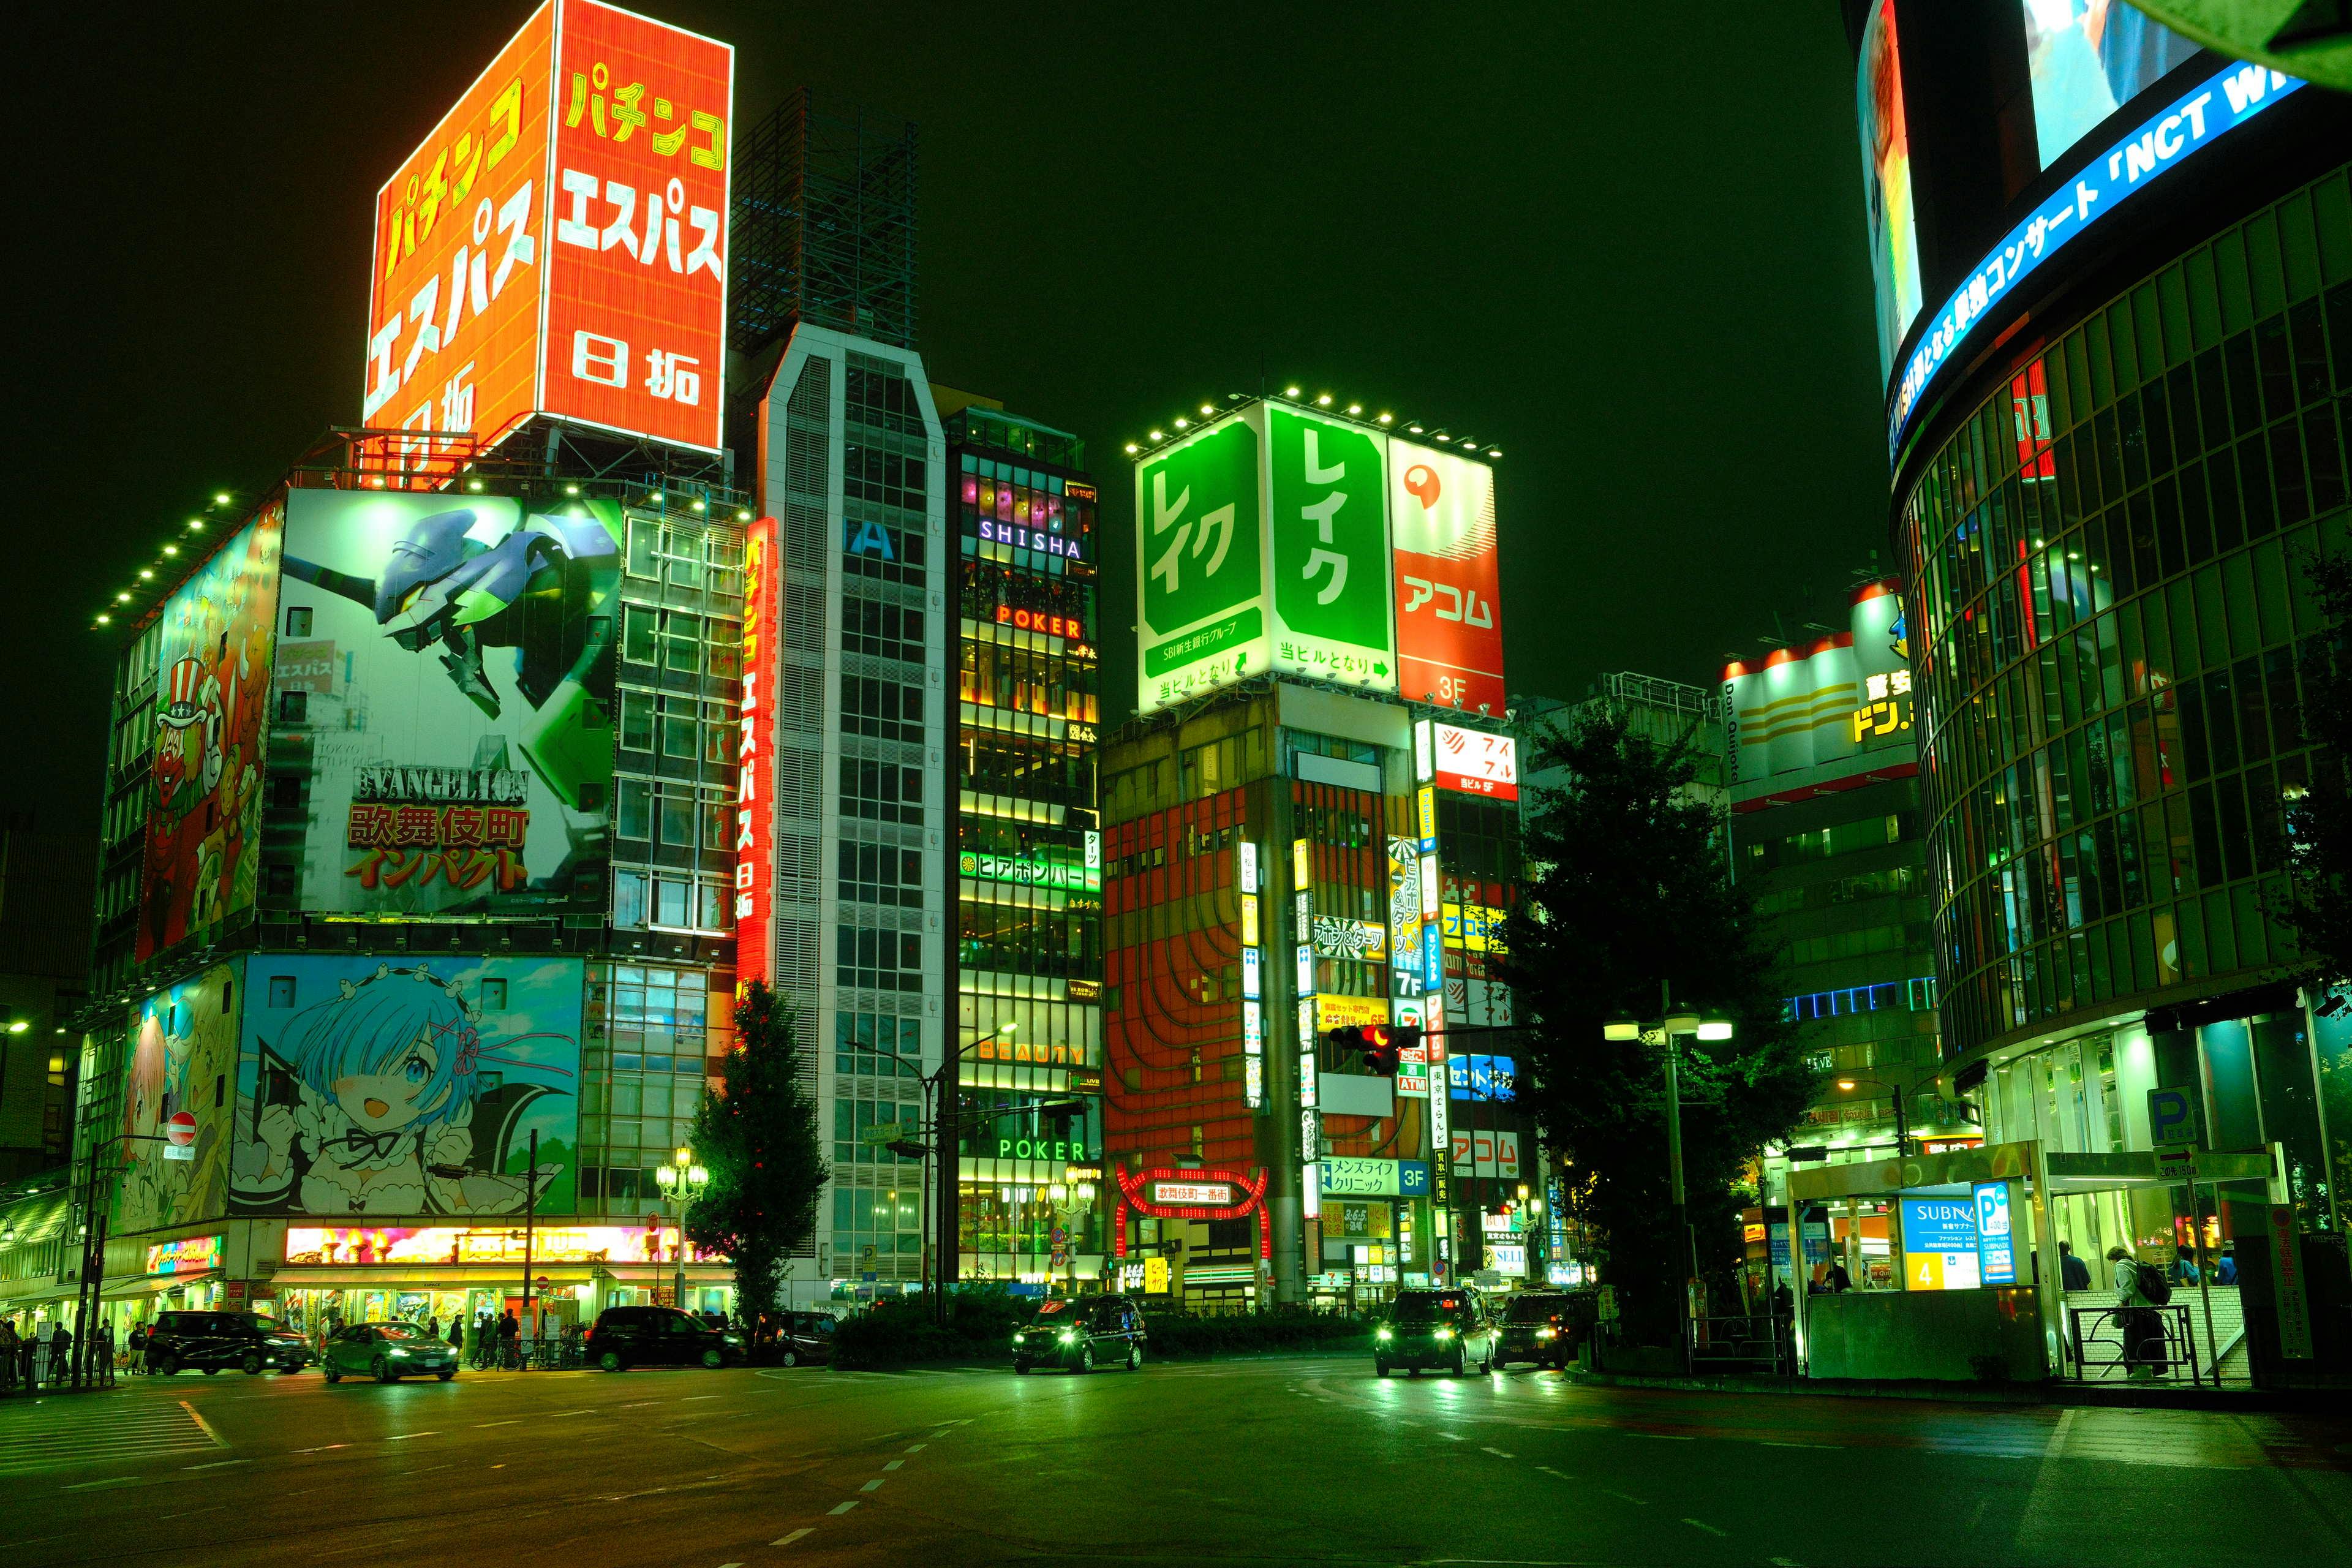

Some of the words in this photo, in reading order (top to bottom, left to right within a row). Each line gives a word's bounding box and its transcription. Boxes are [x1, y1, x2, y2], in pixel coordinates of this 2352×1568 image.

[2223, 61, 2304, 115] WI
[566, 62, 723, 171] パチンコ
[385, 77, 522, 281] パチンコ
[558, 168, 722, 283] エスパス
[366, 179, 535, 422] エスパス
[572, 330, 699, 405] 日拓
[399, 361, 475, 483] 日拓
[1152, 470, 1235, 594] レイク
[1302, 428, 1348, 605] レイク
[981, 521, 1080, 559] SHISHA
[744, 536, 761, 663] パチンコ
[1404, 575, 1493, 629] アコム
[998, 605, 1082, 639] POKER
[1163, 620, 1237, 661] SBI新生銀行グループ
[1280, 642, 1368, 674] 当ビルとなり
[1160, 658, 1230, 699] 当ビルとなり
[1438, 676, 1466, 701] 3F
[1725, 684, 1734, 716] Don
[737, 673, 756, 853] エスパス
[1728, 721, 1740, 782] Quijote
[353, 766, 530, 802] EVANGELION
[1460, 777, 1481, 790] 当ビル
[1483, 779, 1494, 792] 5F
[349, 804, 529, 848] 歌舞伎町
[344, 847, 529, 888] インパクト
[1088, 834, 1097, 864] ダーツ
[1244, 845, 1254, 889] 小松ビル
[980, 856, 1082, 885] ビアポンバー
[736, 862, 753, 919] 日拓
[1404, 858, 1419, 924] ビアポン
[1446, 915, 1503, 938] プロミ
[1396, 971, 1422, 996] 7F
[980, 1041, 1084, 1065] BEAUTY
[1400, 1049, 1423, 1062] たばこ
[1400, 1077, 1426, 1091] ATM
[1433, 1071, 1444, 1144] 東京ぶらんど
[2153, 1091, 2188, 1140] P
[1000, 1139, 1084, 1161] POKER
[1334, 1159, 1393, 1176] メンズライフ
[1436, 1153, 1446, 1172] 買取
[1452, 1137, 1517, 1163] アコム
[1335, 1177, 1383, 1193] クリニック
[1404, 1169, 1424, 1187] 3F
[2179, 1165, 2196, 1176] 150m
[1157, 1186, 1227, 1201] 歌舞伎町一番街
[1980, 1195, 1996, 1232] P
[1497, 1250, 1525, 1262] SELL
[1918, 1262, 1933, 1286] 4
